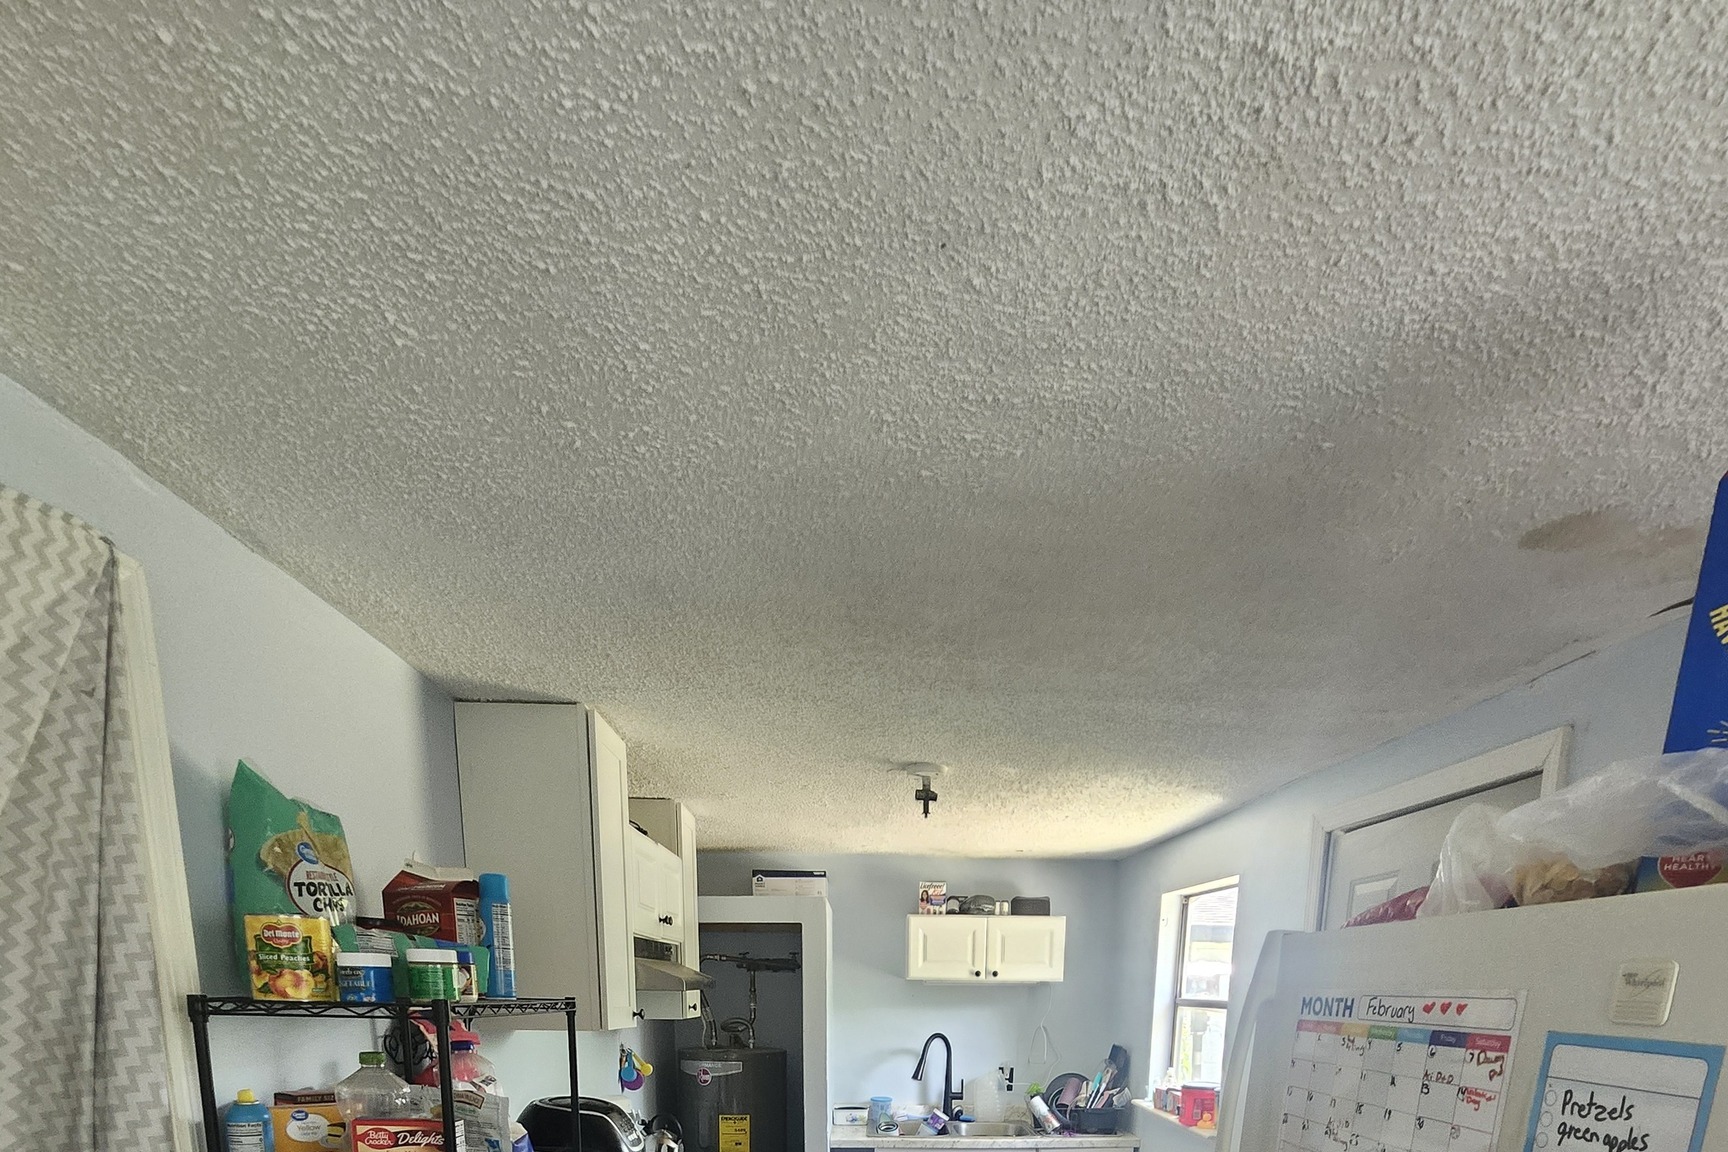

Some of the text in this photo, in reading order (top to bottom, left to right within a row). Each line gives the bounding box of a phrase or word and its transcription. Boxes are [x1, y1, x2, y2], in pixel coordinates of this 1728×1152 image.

[263, 929, 300, 938] Del Monte
[280, 954, 311, 962] Peaches
[1300, 997, 1355, 1018] MONTH
[1366, 996, 1415, 1023] February
[1469, 1052, 1475, 1063] 7
[1561, 1089, 1635, 1122] Pretzels
[297, 1124, 321, 1132] Yellow
[1557, 1121, 1600, 1146] green
[368, 1130, 389, 1140] Betty
[396, 1131, 445, 1148] Delights
[364, 1138, 394, 1146] Crocker
